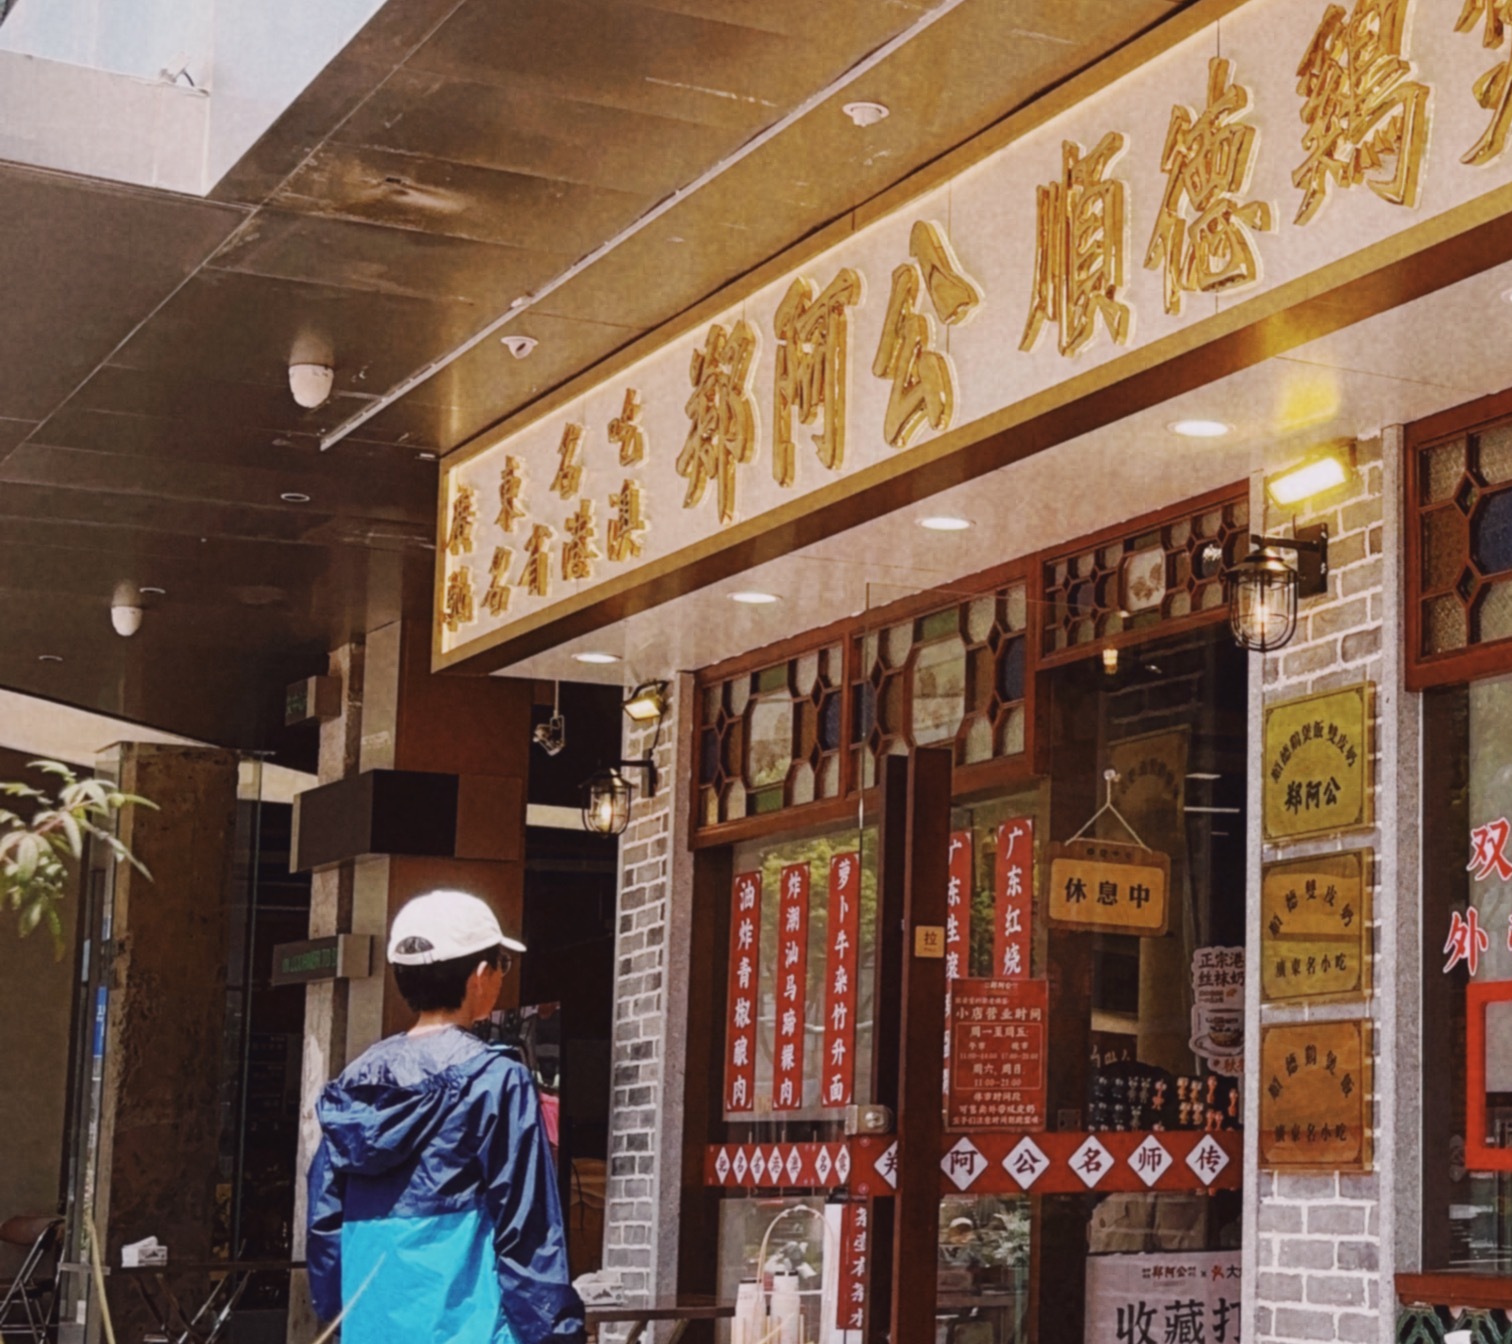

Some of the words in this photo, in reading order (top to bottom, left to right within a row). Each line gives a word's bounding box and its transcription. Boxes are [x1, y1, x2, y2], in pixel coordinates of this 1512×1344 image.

[1064, 877, 1150, 909] 休息中
[924, 930, 938, 946] 拉
[828, 857, 852, 1104] 萝卜牛杂竹升面
[956, 1008, 1042, 1021] 小店营业时间
[1226, 1264, 1242, 1278] 大
